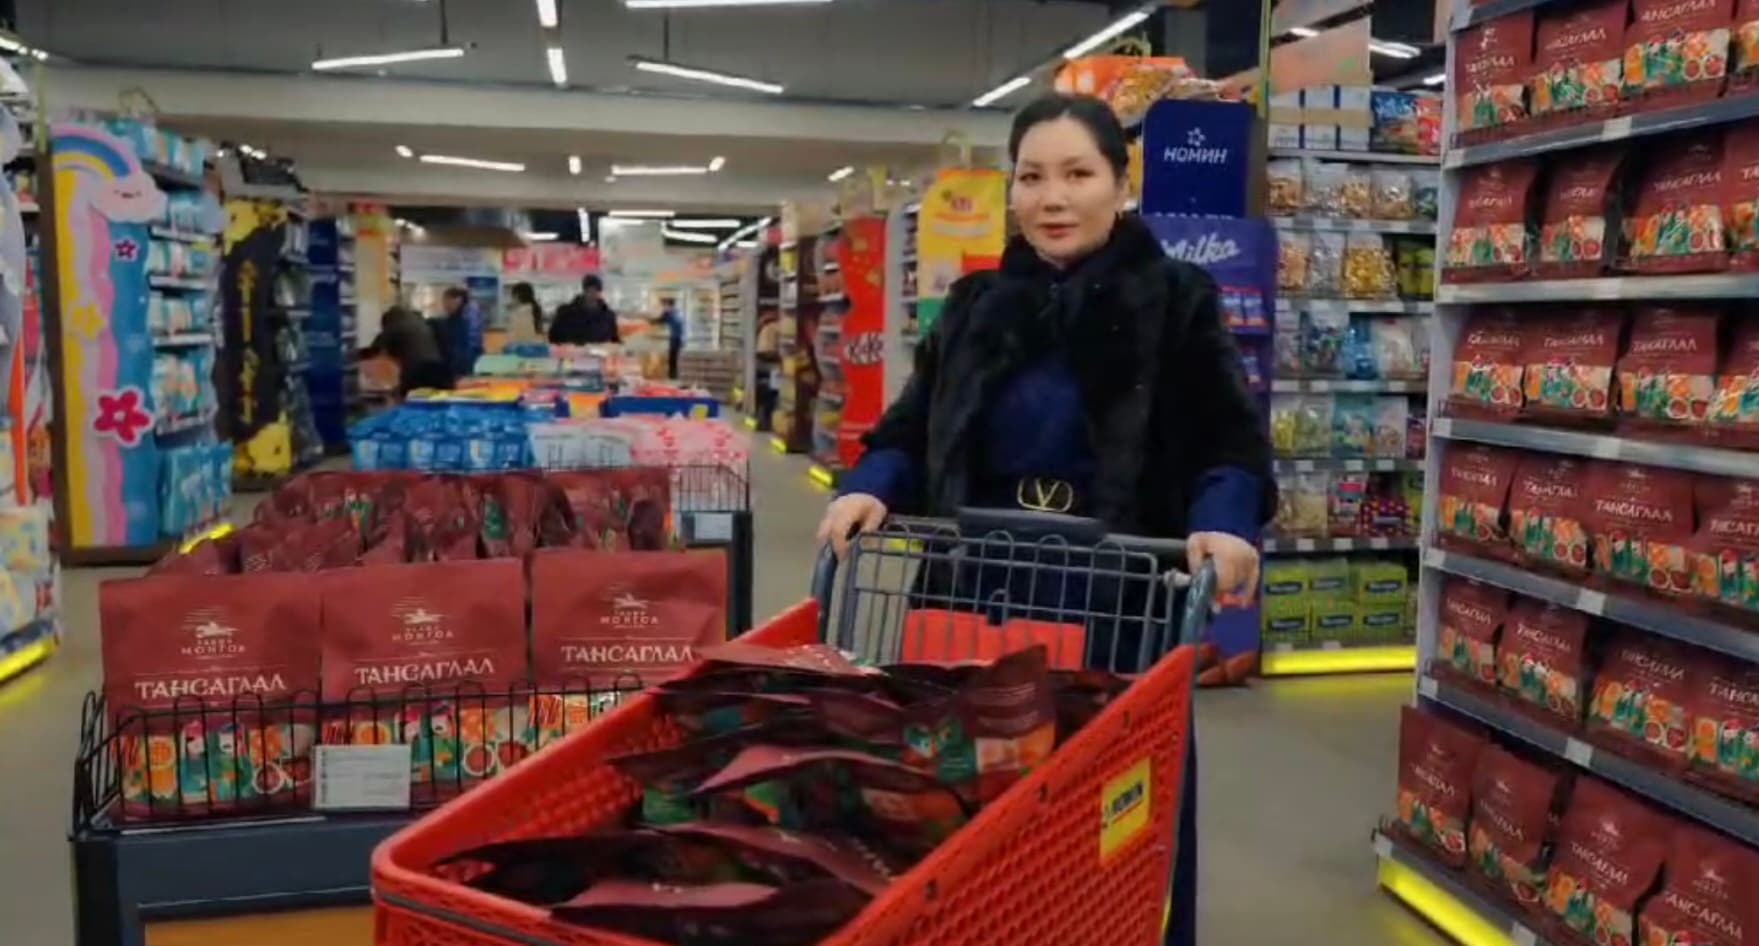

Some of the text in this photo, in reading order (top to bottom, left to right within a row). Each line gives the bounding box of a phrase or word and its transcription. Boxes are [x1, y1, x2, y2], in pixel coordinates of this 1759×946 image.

[1164, 148, 1227, 164] НОМИН
[1161, 232, 1241, 266] Milka
[1596, 499, 1673, 522] ТАНСАГЛАЛ
[561, 644, 696, 663] ТАНСАГЛАЛ
[354, 658, 494, 685] ТАНСАГЛАЛ
[134, 673, 288, 700] ТАНСАГЛАЛ
